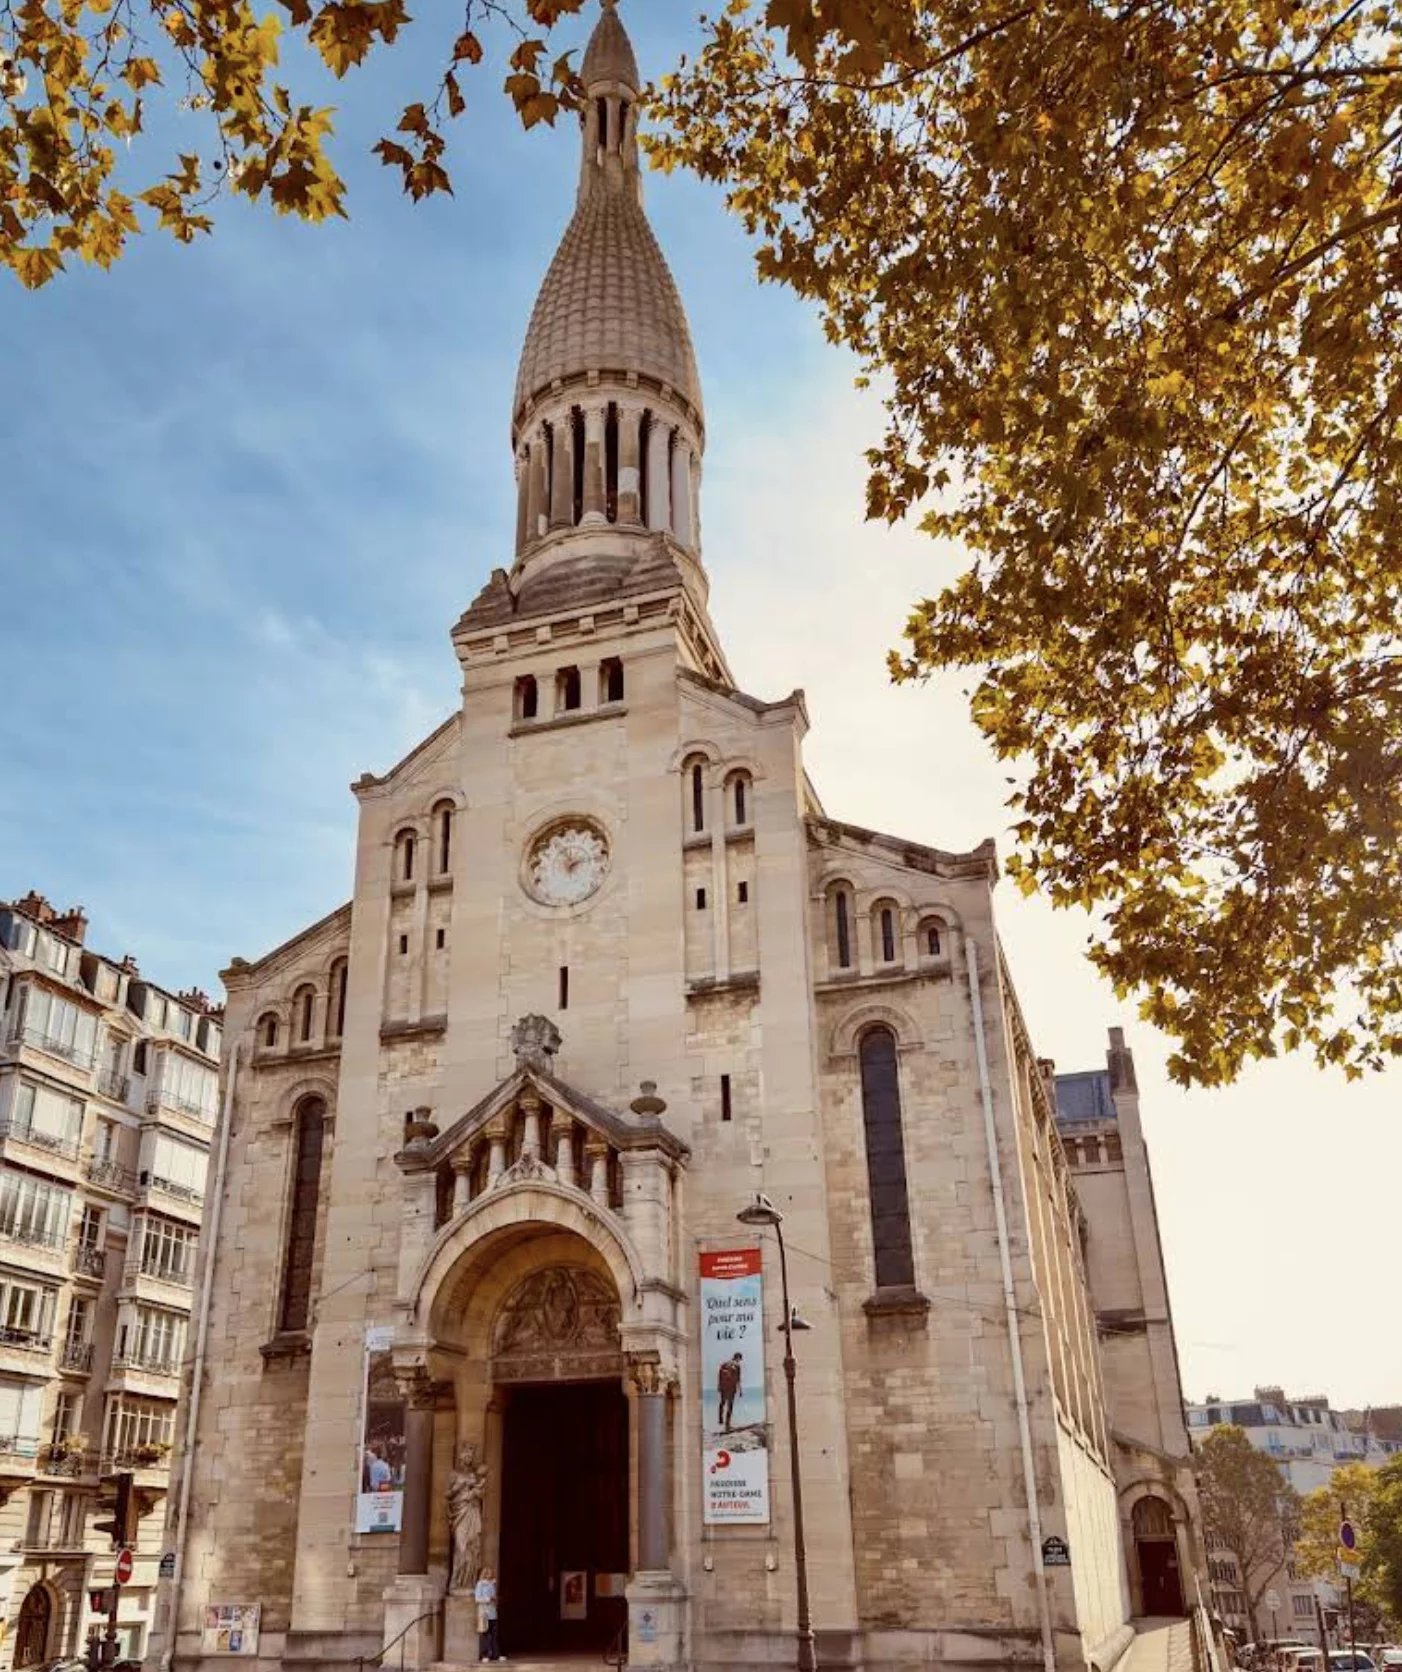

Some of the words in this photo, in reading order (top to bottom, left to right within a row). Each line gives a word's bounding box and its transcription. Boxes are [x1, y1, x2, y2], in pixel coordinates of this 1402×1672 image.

[706, 1296, 731, 1310] Quel
[733, 1298, 757, 1308] sens
[707, 1313, 734, 1326] pour
[716, 1326, 736, 1340] vie
